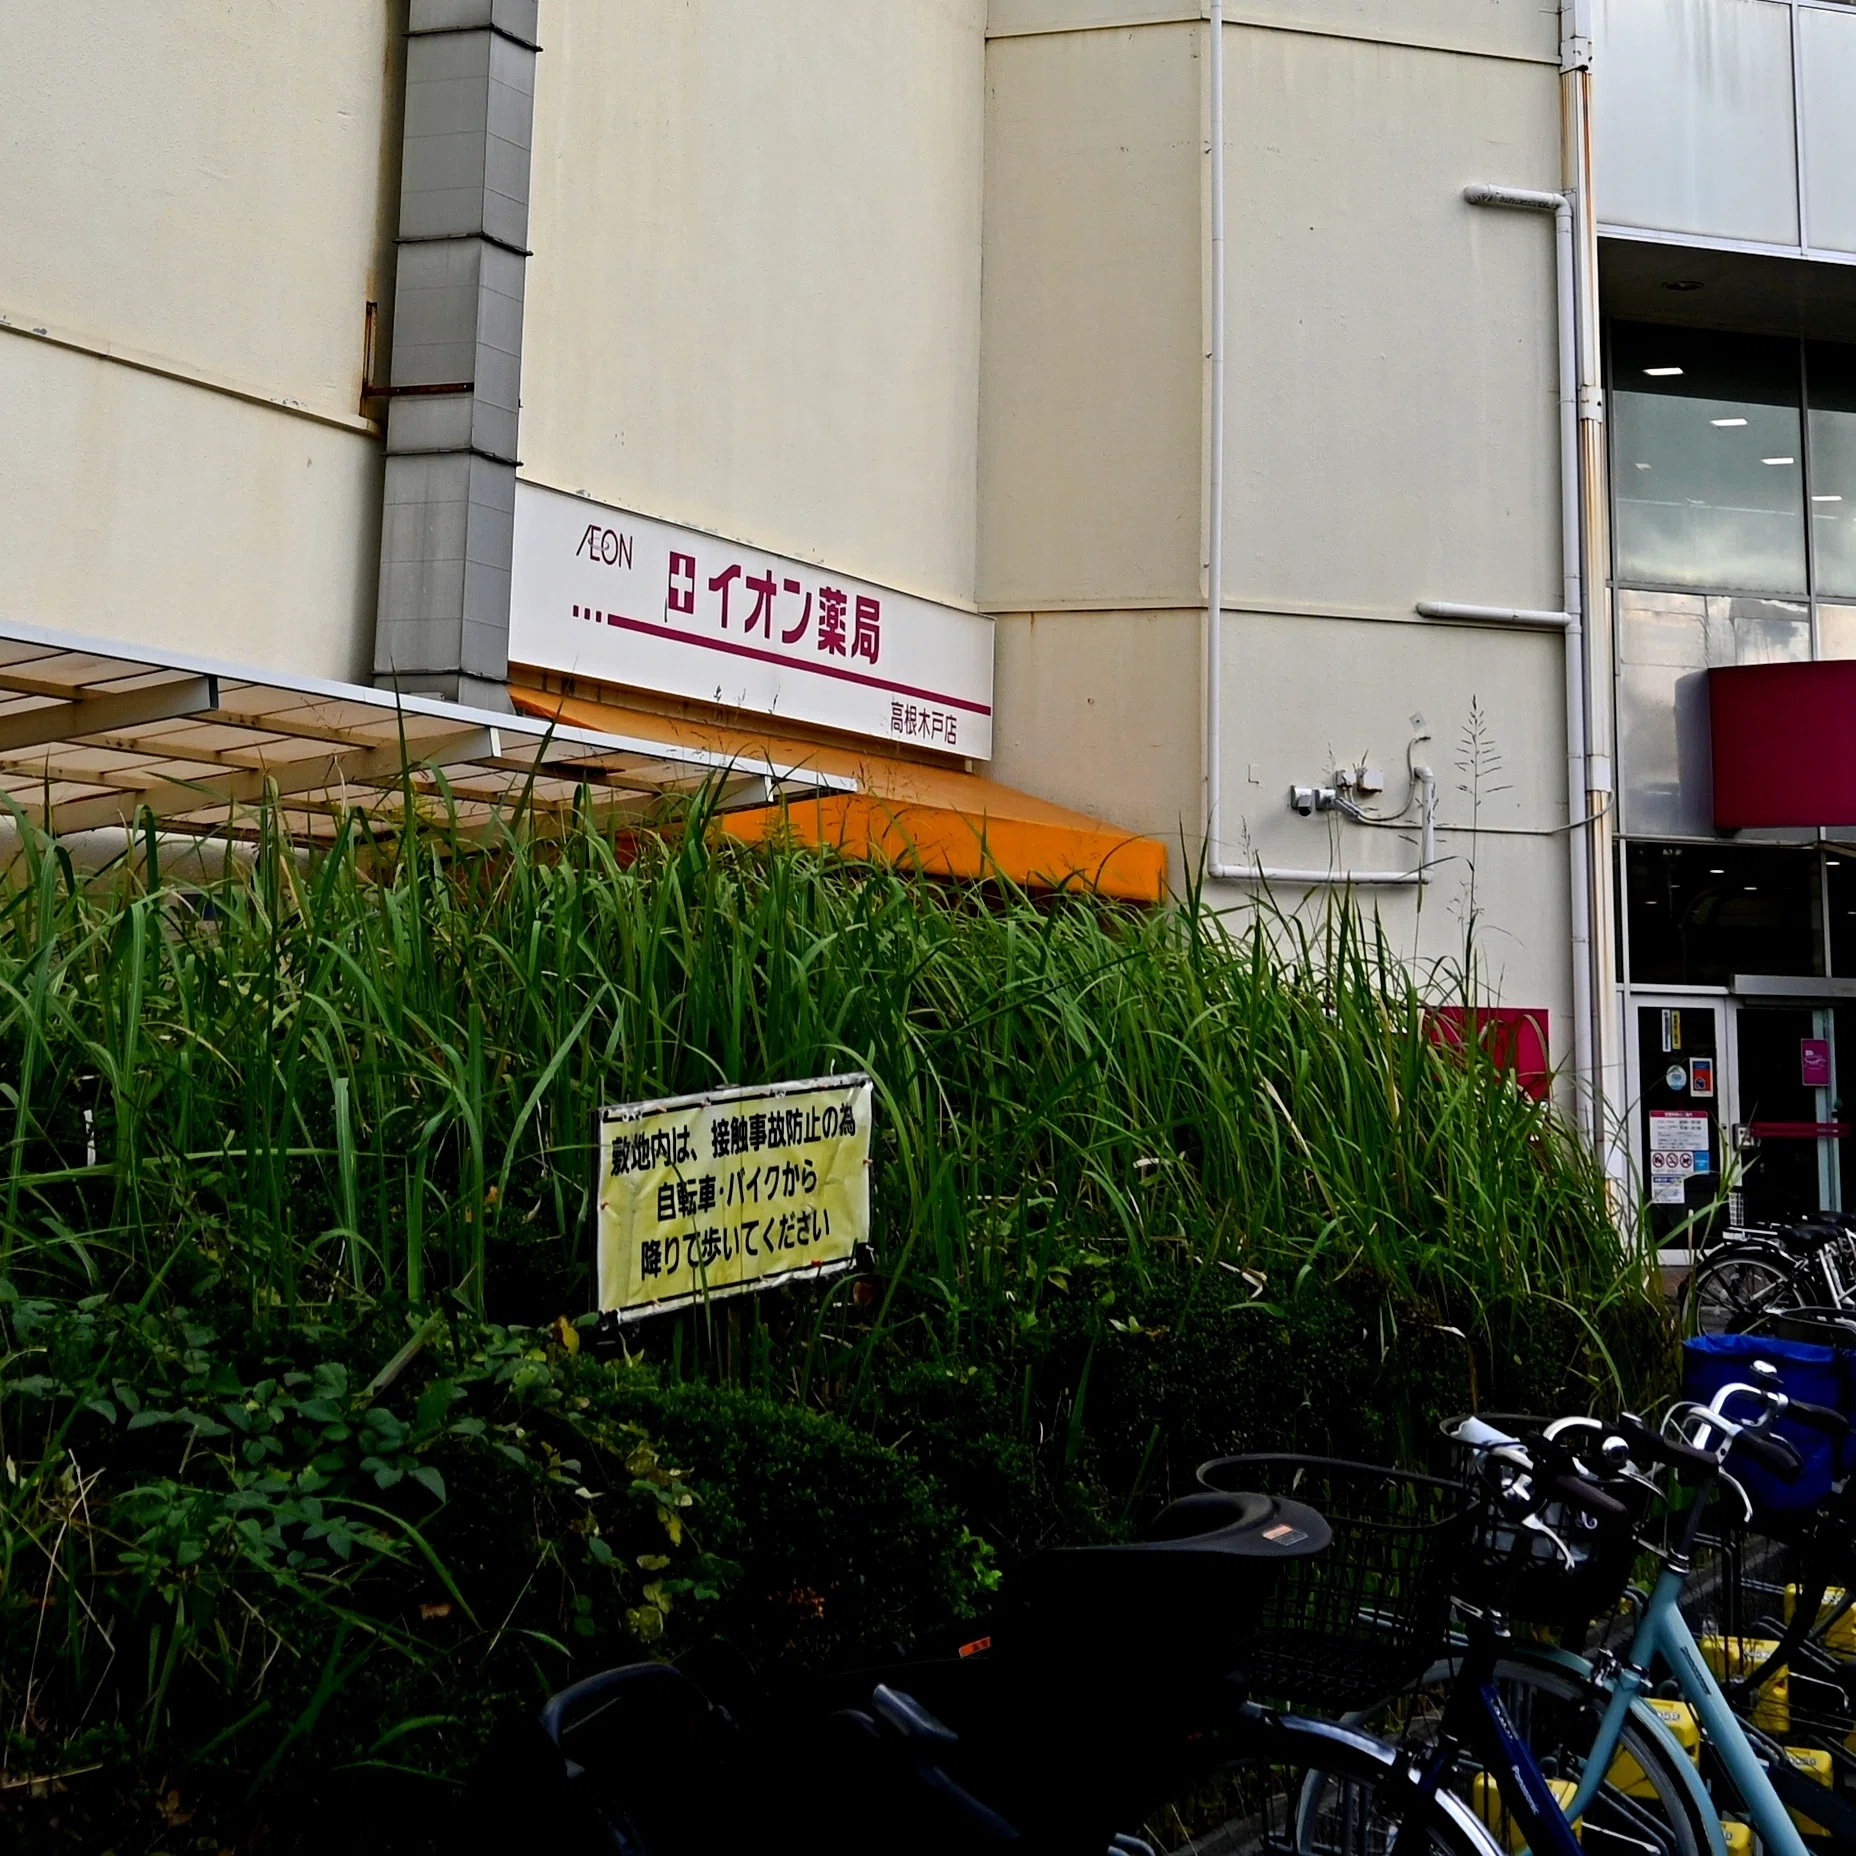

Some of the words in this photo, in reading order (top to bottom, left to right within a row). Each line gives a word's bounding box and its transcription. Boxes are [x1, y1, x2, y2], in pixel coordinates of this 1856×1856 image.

[707, 563, 881, 665] イオン薬局
[890, 700, 959, 746] 高根木戸店
[656, 1158, 818, 1223] 自転車・バイクから
[640, 1208, 831, 1282] 降りて歩いてください
